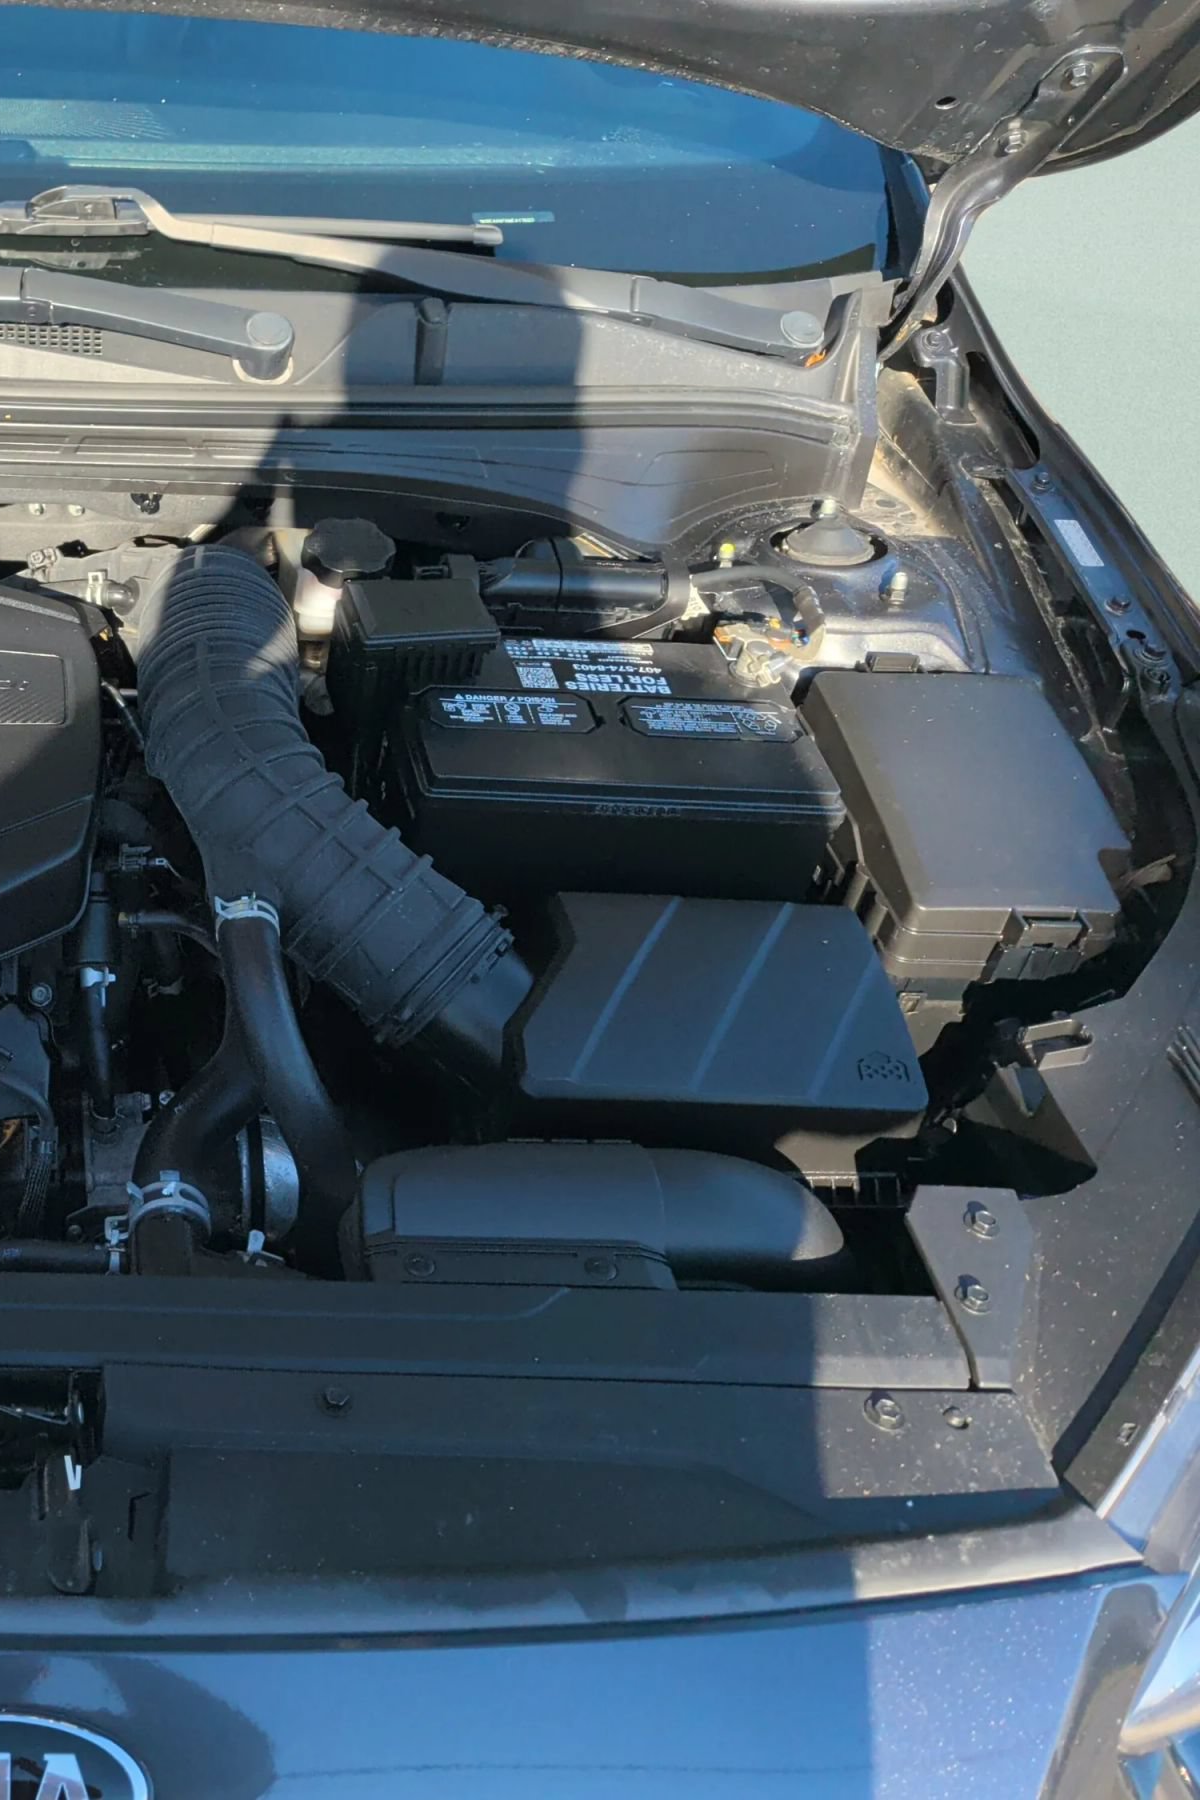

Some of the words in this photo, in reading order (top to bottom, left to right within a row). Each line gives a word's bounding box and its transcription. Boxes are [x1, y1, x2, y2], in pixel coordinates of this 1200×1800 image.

[575, 673, 624, 684] LESS
[629, 675, 668, 686] FOR
[565, 681, 672, 695] BATTERIES
[465, 694, 507, 703] DANGER
[517, 696, 556, 704] POISON
